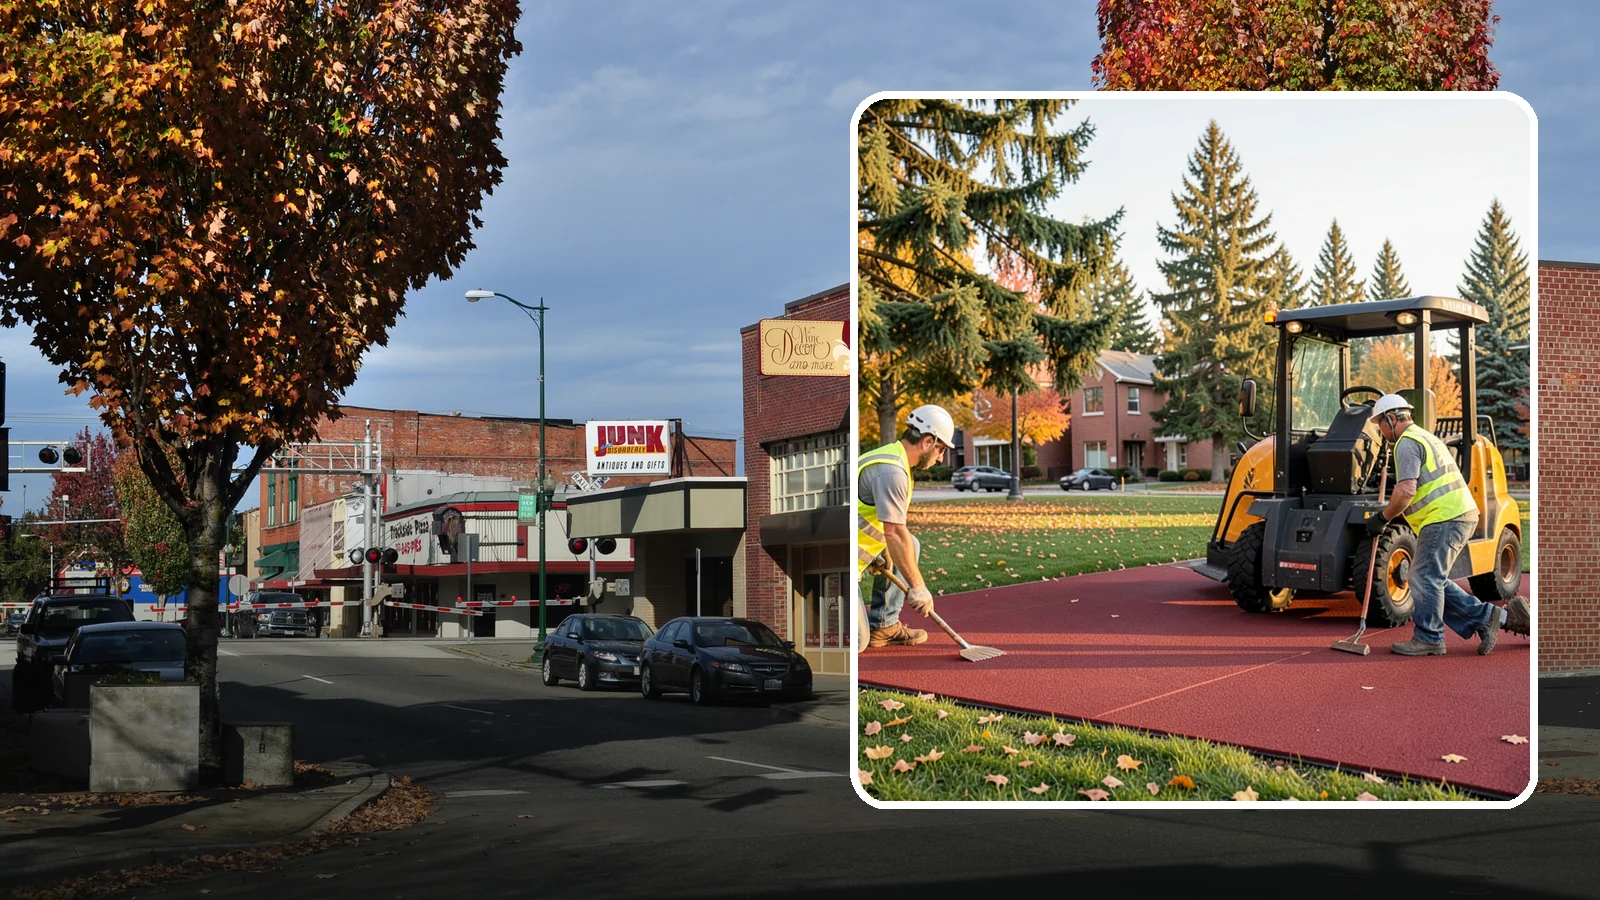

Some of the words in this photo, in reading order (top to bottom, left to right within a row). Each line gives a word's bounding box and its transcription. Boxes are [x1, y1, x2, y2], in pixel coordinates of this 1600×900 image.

[596, 425, 665, 457] JUNK
[608, 446, 646, 454] DISORDERLY
[597, 461, 628, 470] ANTIQUES
[631, 460, 644, 470] AND
[646, 460, 665, 470] GIFTS
[573, 473, 588, 492] RAIL
[390, 521, 413, 540] Trackside
[414, 519, 429, 535] Pizza
